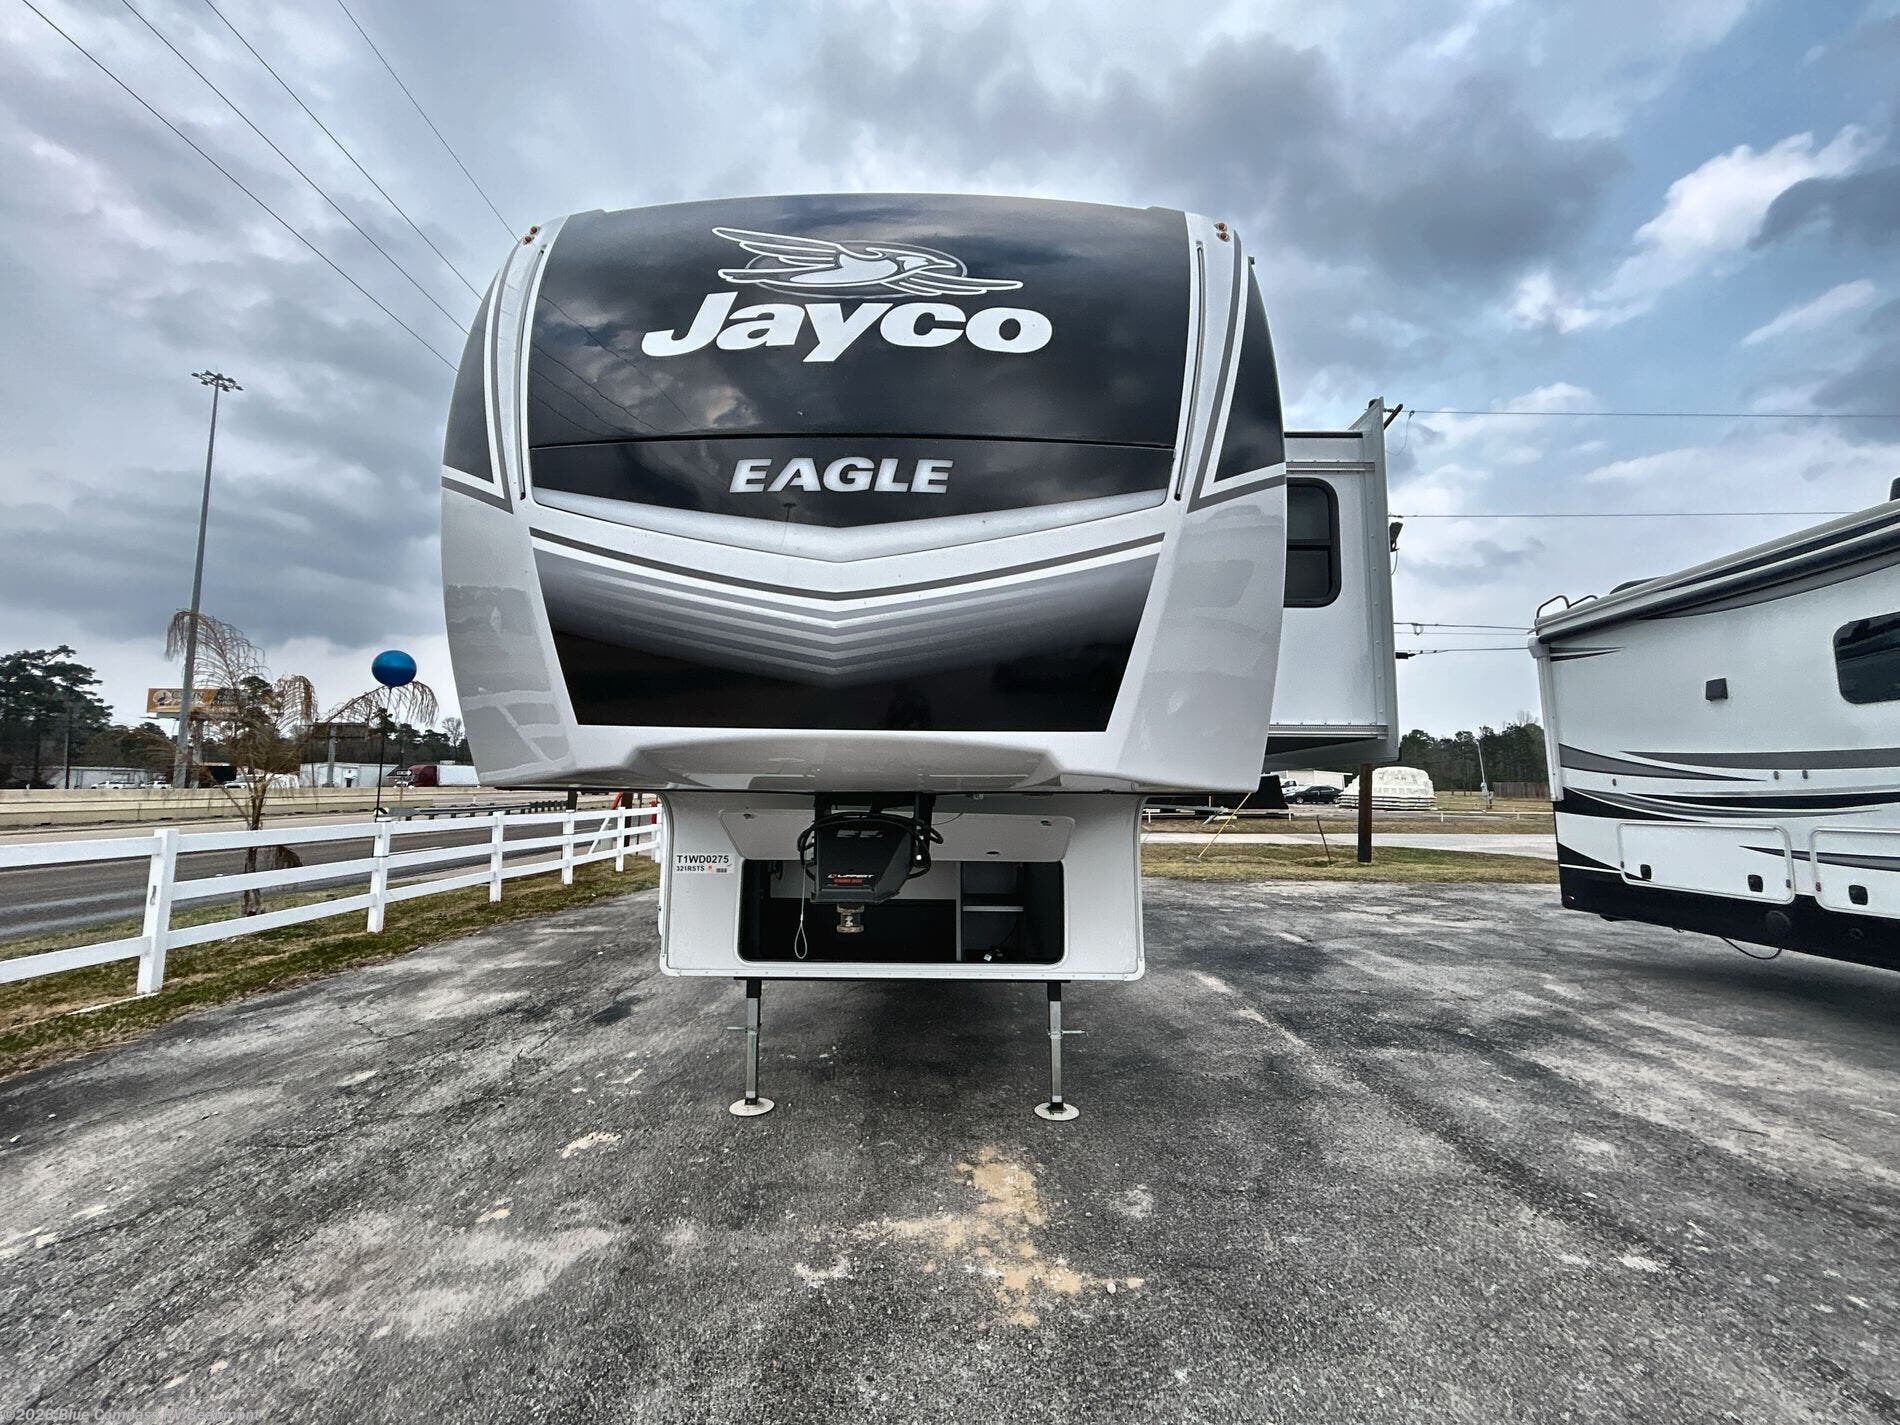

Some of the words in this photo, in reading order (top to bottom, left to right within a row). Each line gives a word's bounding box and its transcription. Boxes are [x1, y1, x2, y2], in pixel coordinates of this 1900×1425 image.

[641, 291, 1053, 362] Jayco
[729, 456, 954, 494] EAGLE
[676, 854, 730, 864] T1WD0275
